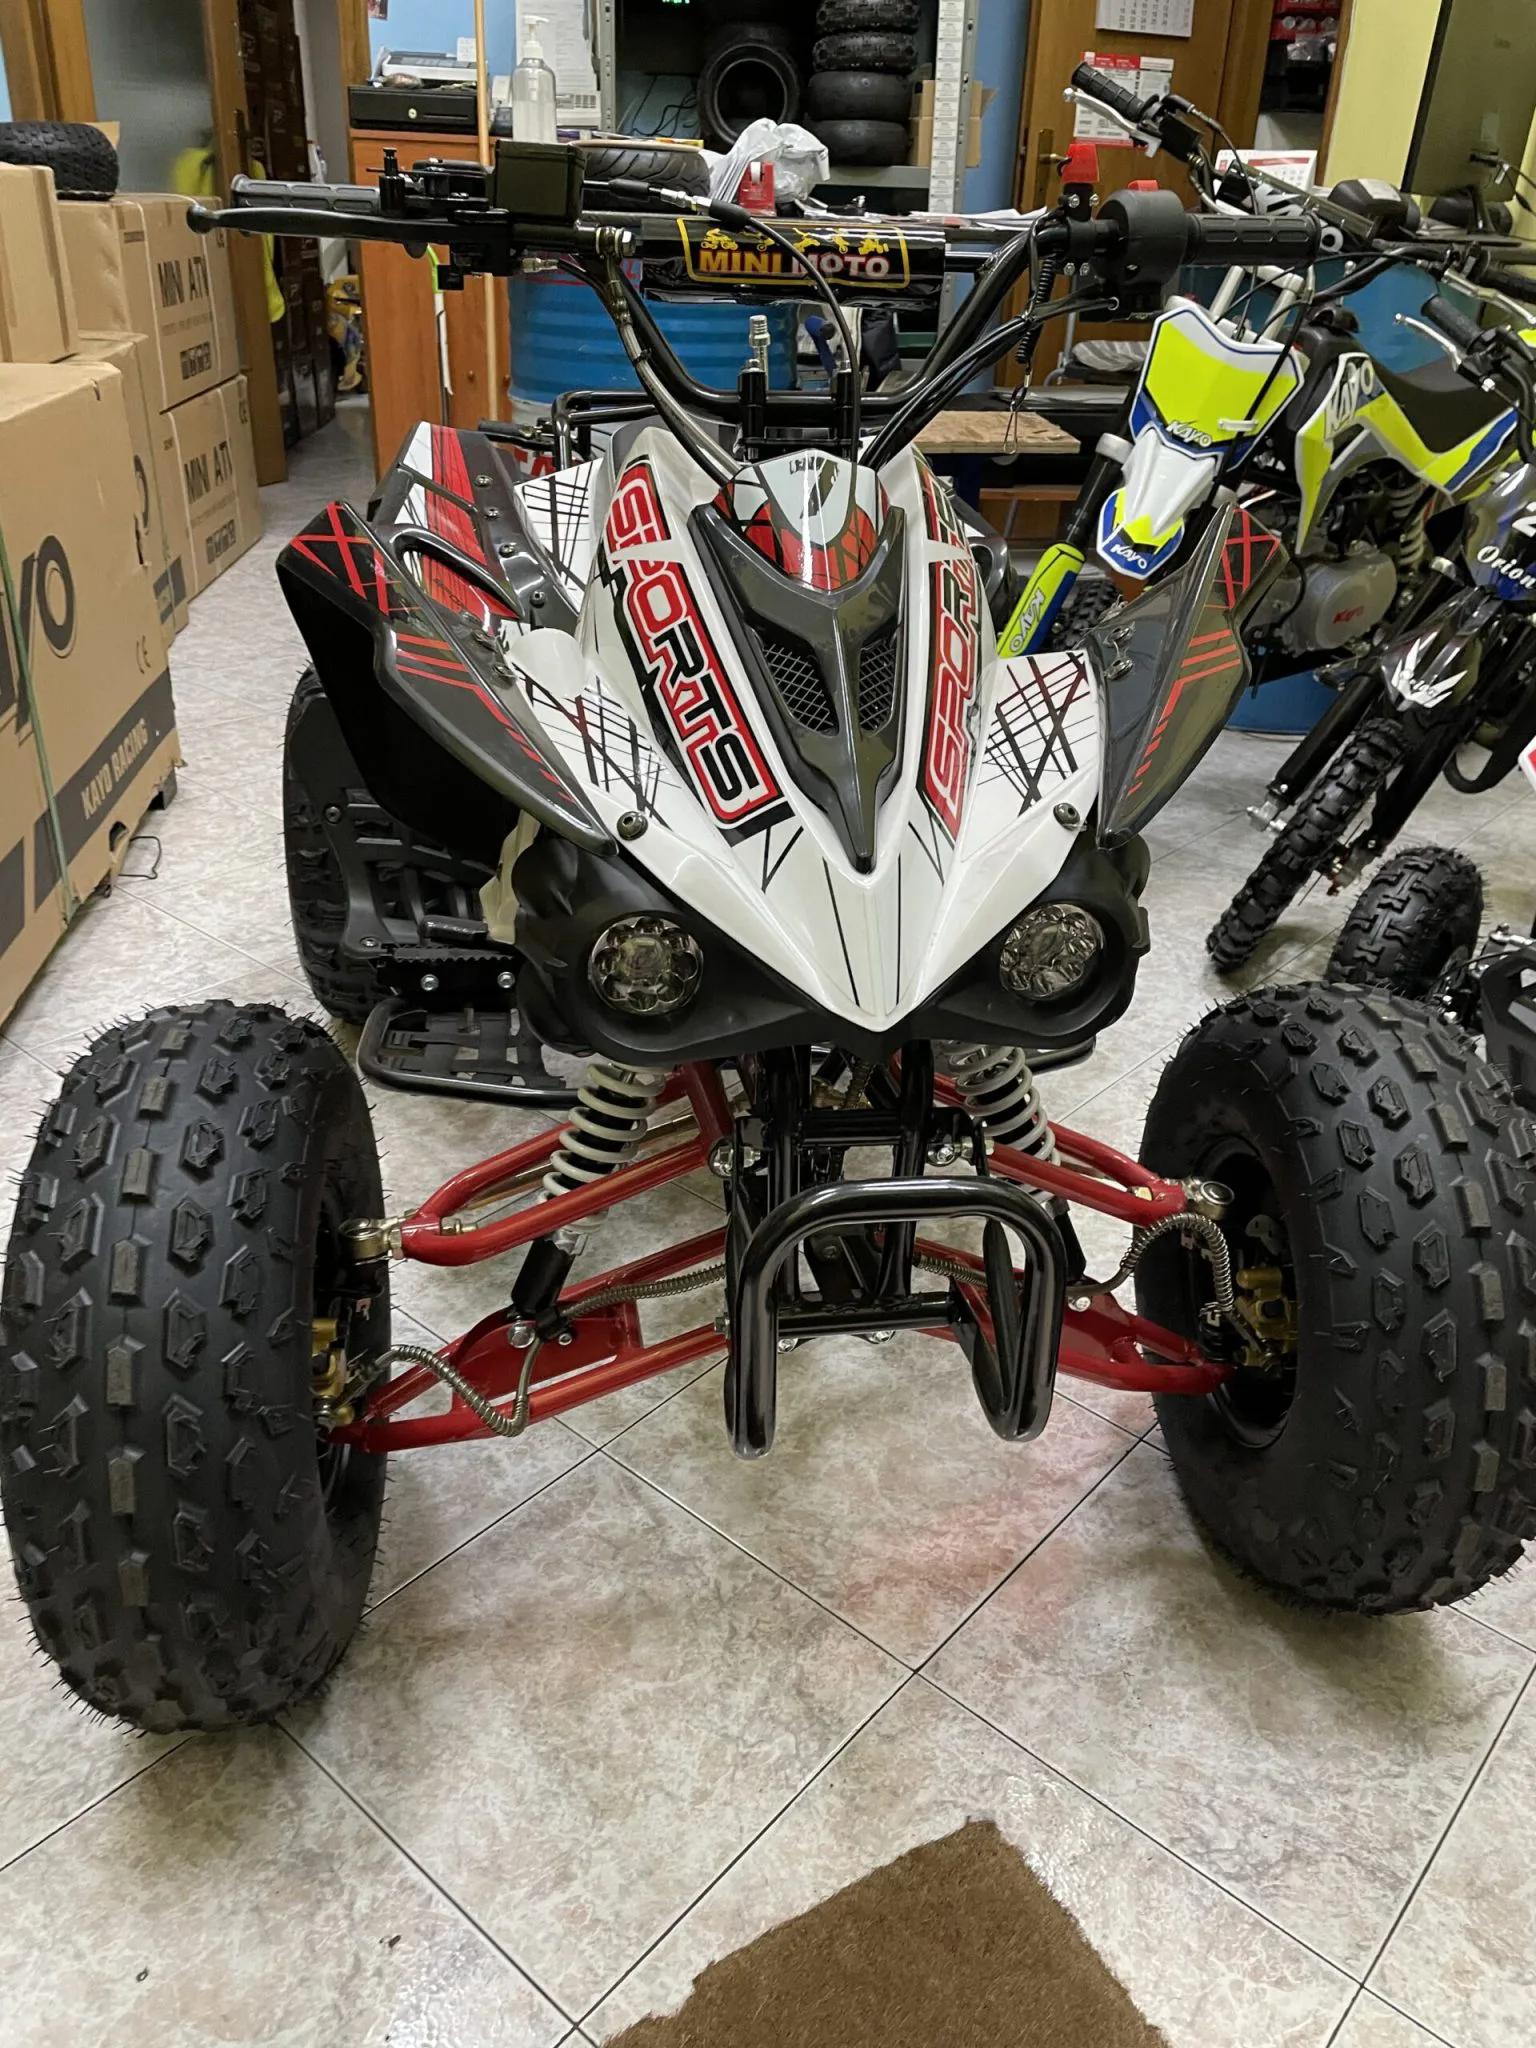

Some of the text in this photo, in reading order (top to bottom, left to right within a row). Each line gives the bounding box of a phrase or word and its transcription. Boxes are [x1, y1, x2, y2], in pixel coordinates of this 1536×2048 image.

[698, 250, 891, 277] MINI MOTO
[1166, 420, 1213, 448] KAYO
[1110, 543, 1148, 570] KAYO
[1476, 545, 1536, 590] Orion
[1010, 587, 1045, 652] KAYO
[611, 478, 768, 812] SPORTS
[80, 717, 149, 820] KAYO RACING
